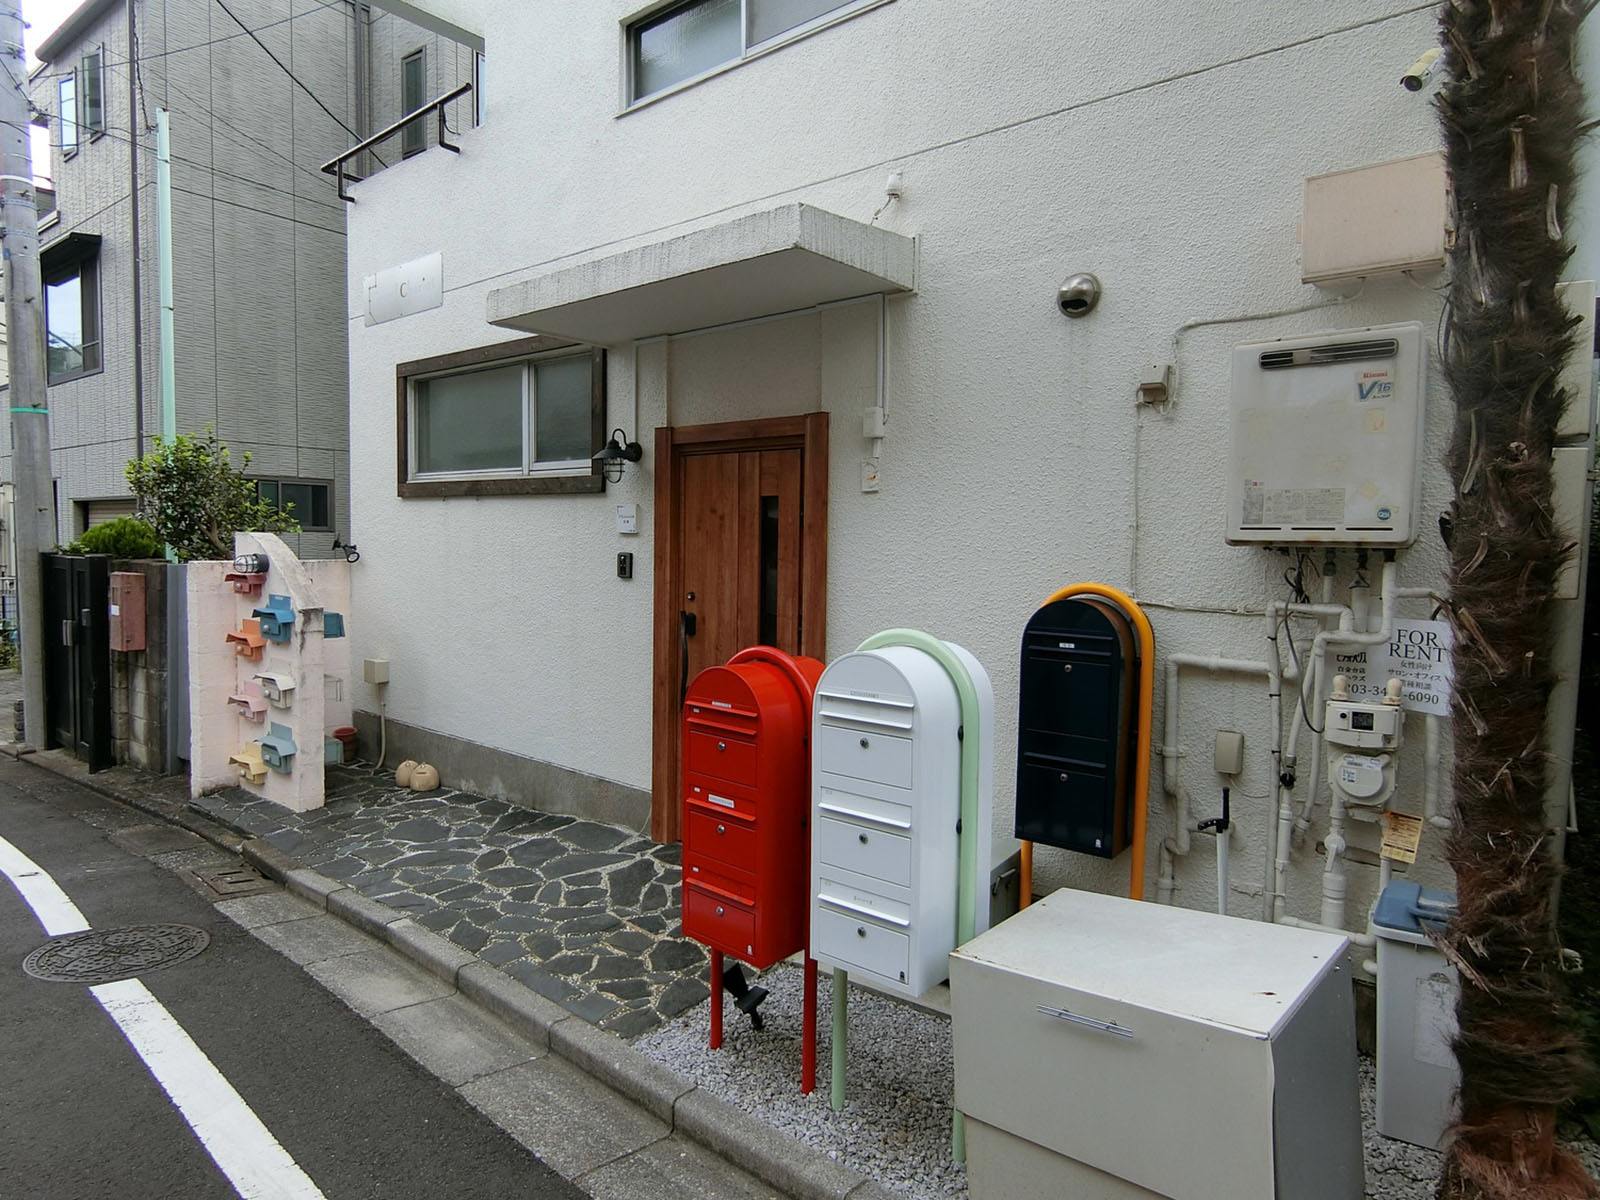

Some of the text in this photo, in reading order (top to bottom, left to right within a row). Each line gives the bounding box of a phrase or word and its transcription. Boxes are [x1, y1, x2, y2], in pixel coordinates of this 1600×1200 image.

[1397, 629, 1438, 647] FOR
[1389, 643, 1446, 662] RENT
[1388, 669, 1441, 681] サロン・オフィス
